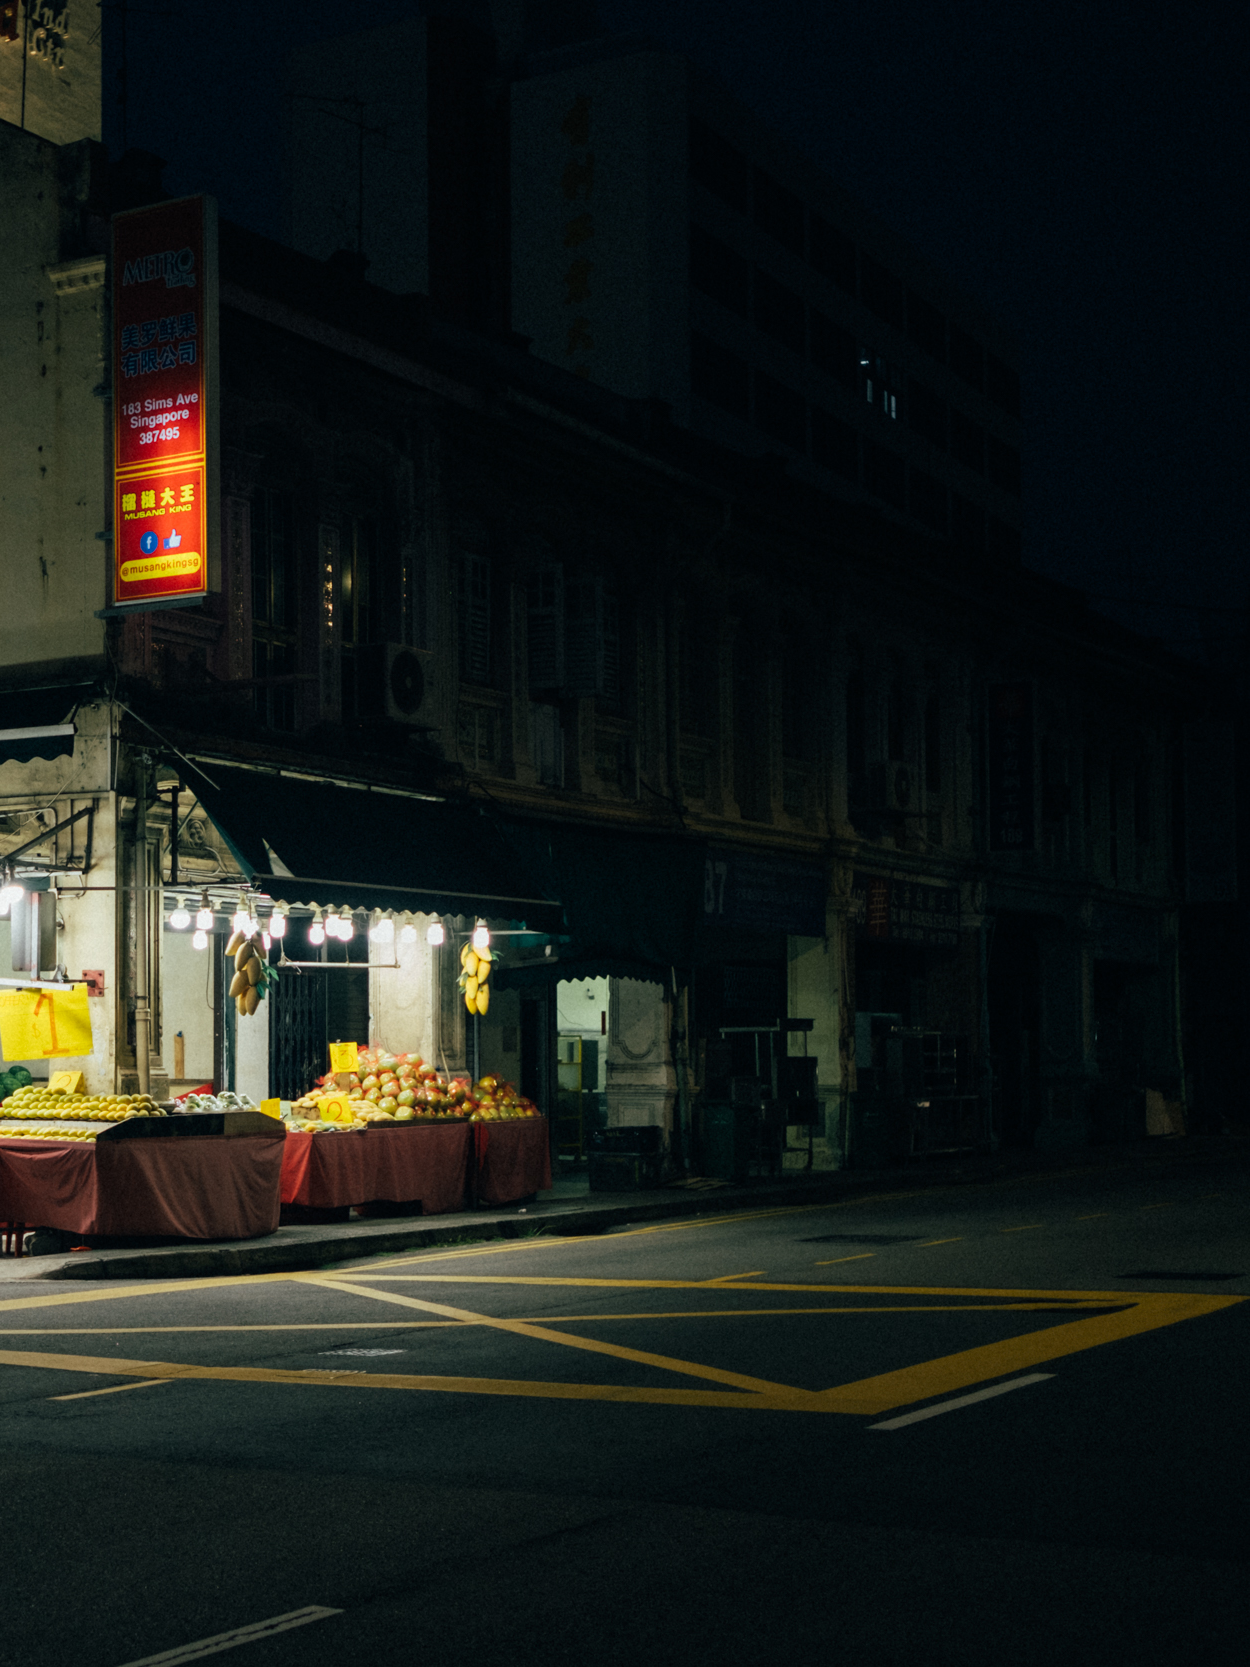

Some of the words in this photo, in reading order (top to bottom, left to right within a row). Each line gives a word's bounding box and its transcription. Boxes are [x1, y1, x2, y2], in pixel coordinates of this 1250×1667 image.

[123, 247, 195, 286] METRO
[122, 312, 197, 350] 美罗鲜果
[122, 340, 197, 378] 有限公司
[122, 402, 142, 416] 183
[144, 397, 173, 412] Sims
[176, 393, 199, 406] Ave
[130, 408, 190, 429] Singapore
[139, 427, 180, 445] 387495
[124, 507, 166, 520] MUSANG
[169, 504, 192, 514] KING
[122, 557, 199, 577] @musangkingsg
[327, 1101, 344, 1121] 2
